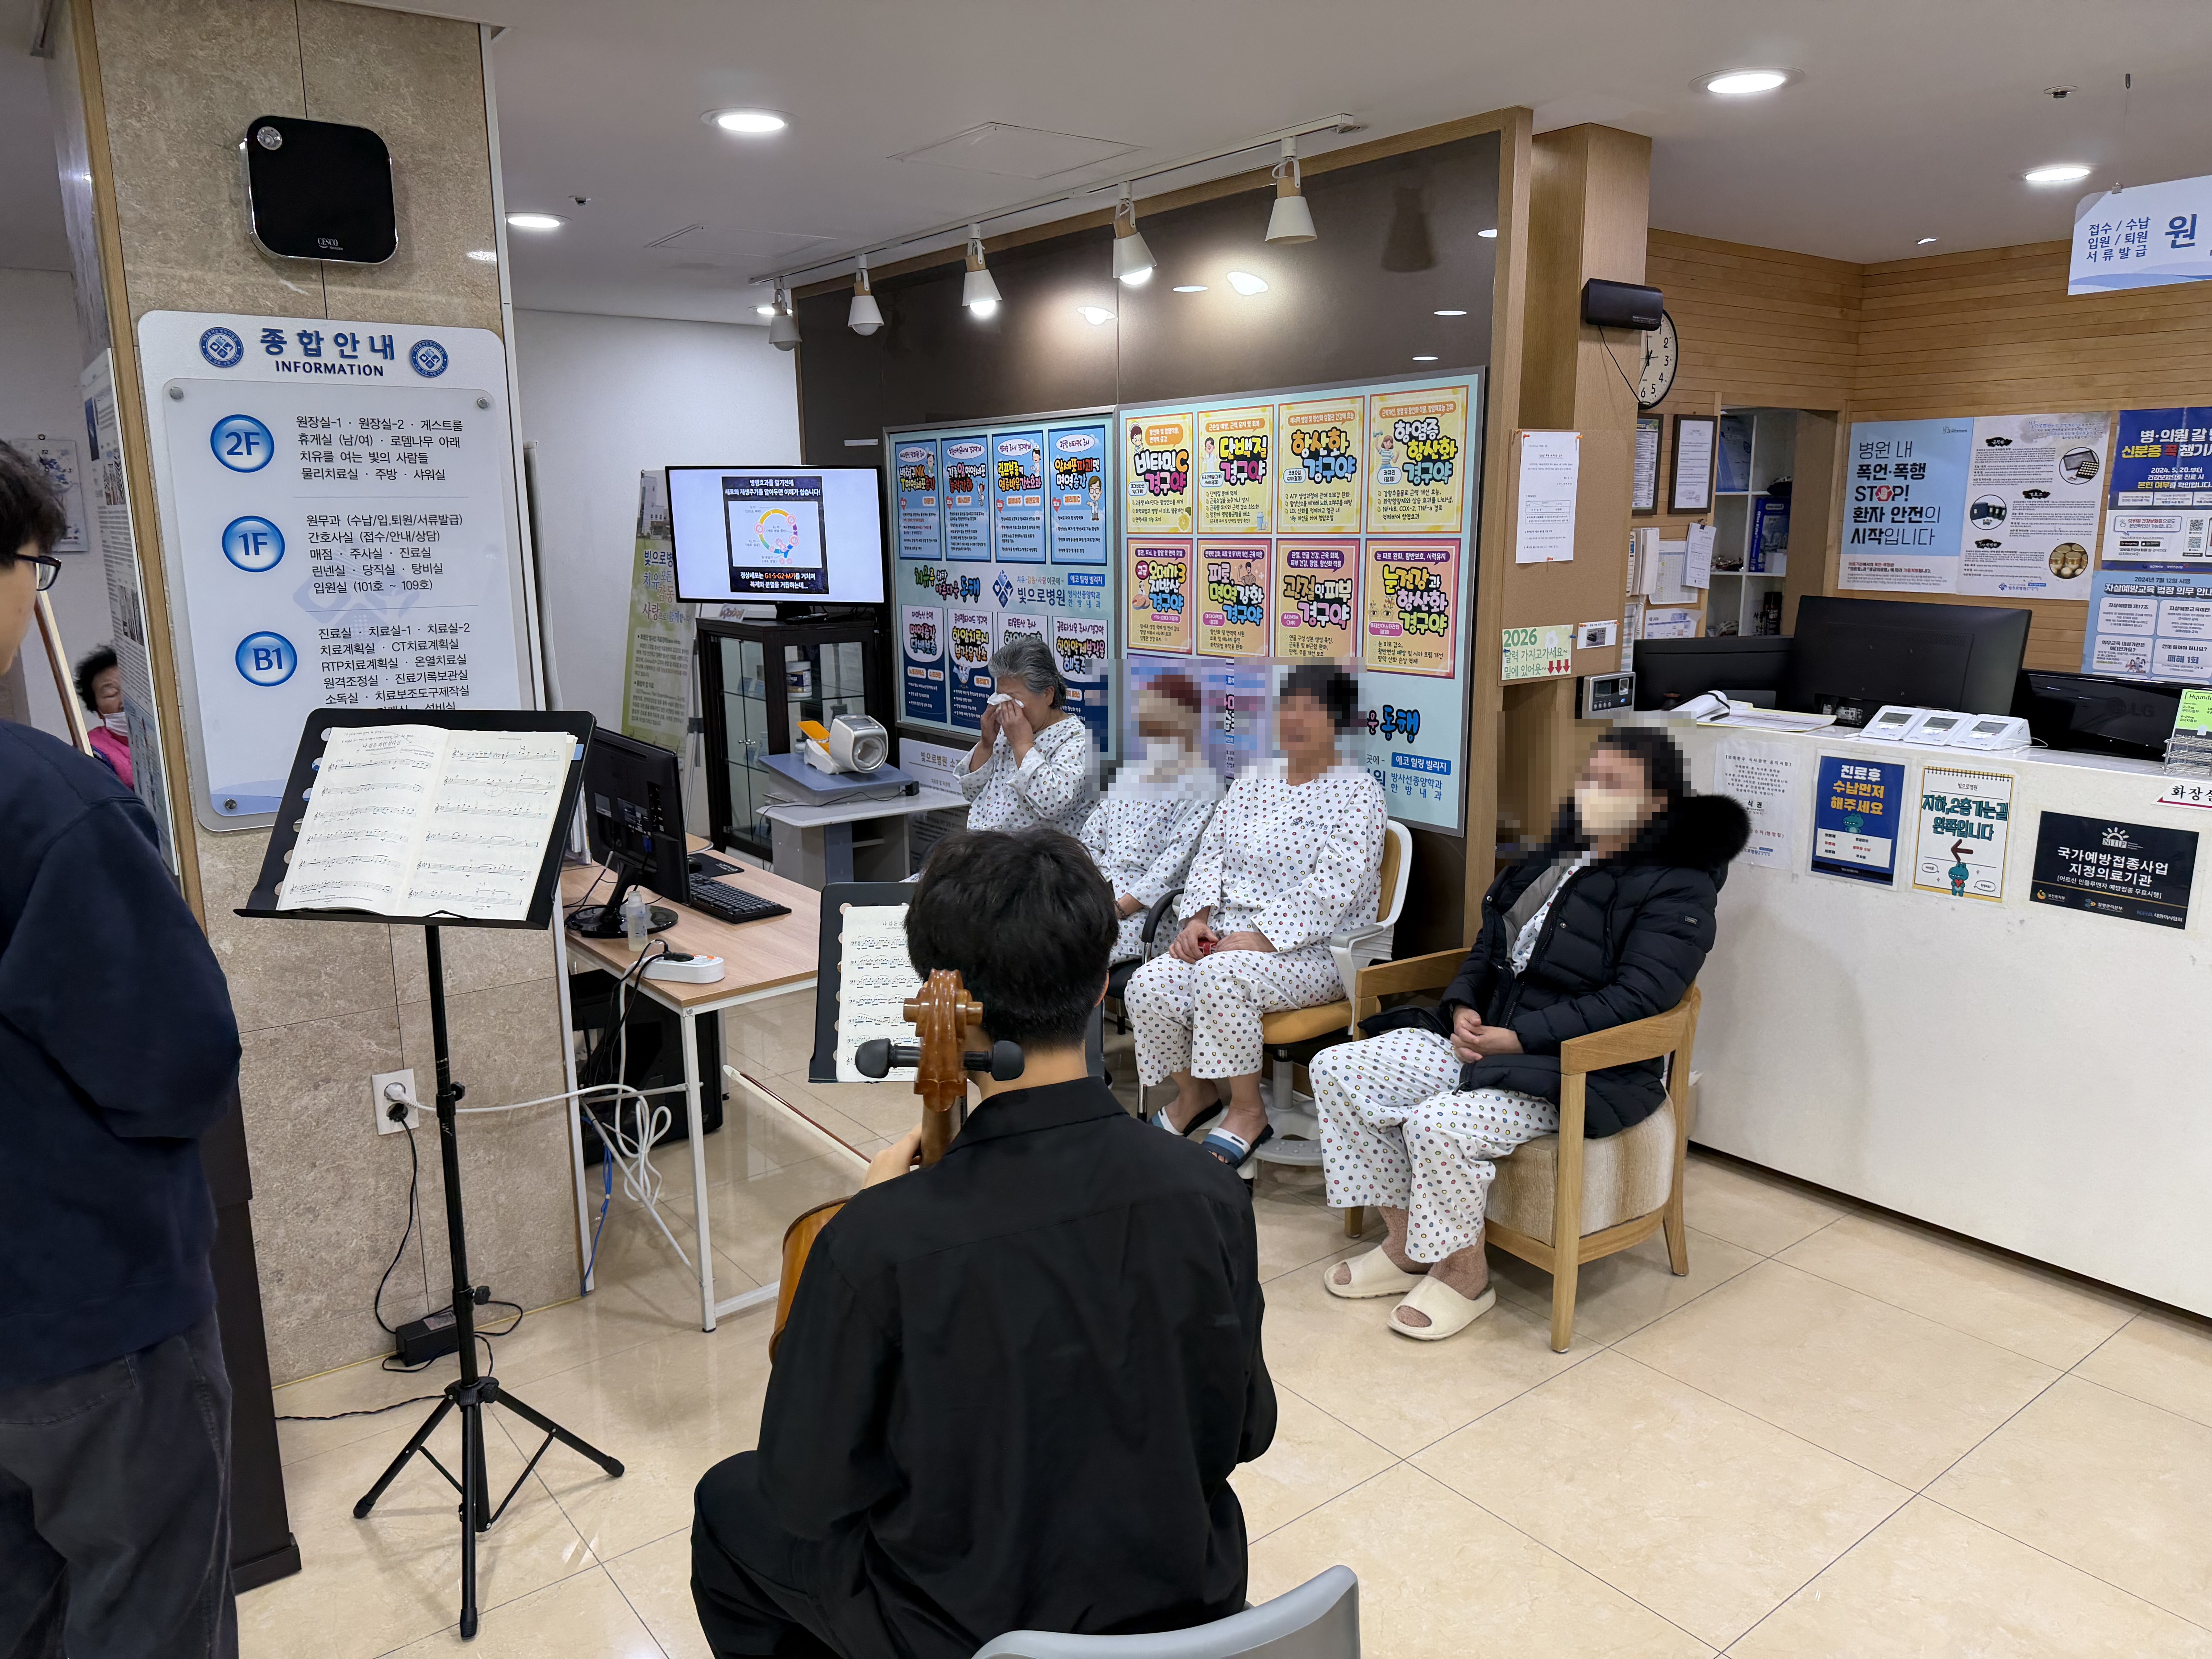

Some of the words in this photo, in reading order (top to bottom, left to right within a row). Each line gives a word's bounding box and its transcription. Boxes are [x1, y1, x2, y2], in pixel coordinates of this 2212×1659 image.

[2089, 222, 2112, 236] 접수
[2126, 217, 2150, 230] 수납
[318, 237, 338, 246] CESCO
[2088, 236, 2110, 249] 입원
[2124, 231, 2148, 244] 퇴원
[260, 328, 395, 360] 종합안내
[1664, 338, 1668, 348] 2
[276, 360, 383, 376] INFORMATION
[1664, 356, 1669, 366] 3
[1659, 372, 1664, 383] 4
[1640, 387, 1646, 397] 6
[1651, 383, 1656, 394] 5
[296, 416, 342, 428] 원장실-1
[359, 418, 404, 430] 원장실-2
[421, 419, 463, 431] 게스트룸
[1394, 417, 1440, 444] 항염증
[225, 431, 261, 457] 2F
[298, 434, 332, 446] 휴게실
[339, 434, 373, 446] (남/여)
[390, 435, 433, 447] 로뎀나무
[439, 436, 460, 448] 아래
[1291, 427, 1350, 459] 항산화
[2141, 429, 2188, 443] 병·의원
[2192, 428, 2207, 442] 갈
[1219, 435, 1268, 460] 단백질
[1407, 436, 1458, 461] 항산화
[1860, 441, 1890, 459] 병원
[1896, 441, 1912, 458] 내
[2121, 445, 2162, 458] 신분증
[300, 451, 334, 463] 치유를
[340, 452, 362, 463] 여는
[369, 452, 390, 464] 빛의
[397, 453, 428, 464] 사람들
[1134, 449, 1189, 476] 비타민C
[302, 467, 358, 480] 물리치료실
[375, 468, 397, 480] 주방
[414, 469, 445, 481] 샤워실
[1219, 460, 1267, 486] 경구약
[1303, 455, 1357, 484] 경구약
[1403, 462, 1453, 486] 경구약
[1856, 463, 1926, 481] 폭언·폭행
[1056, 472, 1087, 490] 면역증강
[1144, 472, 1187, 496] 경구약
[306, 515, 340, 526] 원무과
[347, 514, 462, 526] (수납/입,퇴원/서류발급)
[1853, 506, 1885, 523] 환자
[1891, 506, 1940, 523] 안전의
[239, 532, 268, 557] 1F
[308, 532, 353, 543] 간호사실
[360, 531, 440, 543] (접수/안내/상담)
[1851, 528, 1935, 545] 시작입니다
[310, 548, 332, 560] 매점
[350, 548, 383, 559] 주사실
[399, 547, 431, 558] 진료실
[312, 565, 345, 576] 린넨실
[362, 564, 395, 575] 당직실
[412, 563, 443, 574] 탕비실
[915, 565, 935, 588] 치유를
[1138, 565, 1147, 576] 고급
[1149, 560, 1187, 584] 오메가3
[1208, 562, 1234, 584] 피로,
[314, 582, 347, 594] 입원실
[354, 580, 383, 592] (101호
[402, 579, 432, 591] 109호)
[658, 585, 674, 603] 감동
[961, 575, 981, 603] 동행
[1068, 591, 1100, 599] 방사선종양학과
[1149, 579, 1180, 593] 지방산
[1209, 583, 1264, 604] 면역강화
[2105, 584, 2155, 594] 자살예방교육
[2157, 586, 2174, 594] 법정
[2176, 587, 2194, 595] 의무
[1018, 588, 1065, 606] 빛으로병원
[1149, 593, 1184, 614] 경구약
[1396, 589, 1449, 612] 항산화
[1223, 604, 1263, 626] 경구약
[1297, 601, 1351, 630] 경구약
[1398, 611, 1448, 637] 경구약
[319, 627, 351, 639] 진료실
[369, 625, 411, 637] 치료실-1
[428, 623, 470, 634] 치료실-2
[910, 623, 936, 639] 면역증강
[1503, 628, 1537, 647] 2026
[320, 642, 375, 656] 치료계획실
[392, 638, 459, 652] CT치료계획실
[253, 647, 283, 671] B1
[322, 658, 398, 672] RTP치료계획실
[415, 654, 466, 667] 온열치료실
[324, 675, 378, 689] 원격조정실
[395, 669, 468, 684] 진료기록보관실
[1504, 666, 1518, 678] 밑에
[326, 692, 358, 704] 소독실
[376, 685, 469, 701] 치료보조도구제작실
[1380, 705, 1420, 744] 동행
[921, 752, 947, 767] 빛으로병원
[1396, 756, 1409, 765] 에코
[1411, 758, 1424, 768] 힐링
[1426, 760, 1447, 772] 빌리지
[1391, 773, 1442, 790] 방사선종양학과
[1841, 765, 1881, 782] 진료후
[1833, 780, 1884, 799] 수납먼저
[1831, 796, 1883, 815] 해주세요
[1932, 816, 1994, 841] 왼쪽입니다
[2102, 838, 2128, 849] NIP
[2057, 846, 2169, 876] 국가예방접종사업
[2069, 863, 2152, 888] 지정의료기관
[2057, 875, 2076, 884] [어르신
[2078, 879, 2107, 890] 인플루엔자
[2109, 884, 2133, 895] 예방접종
